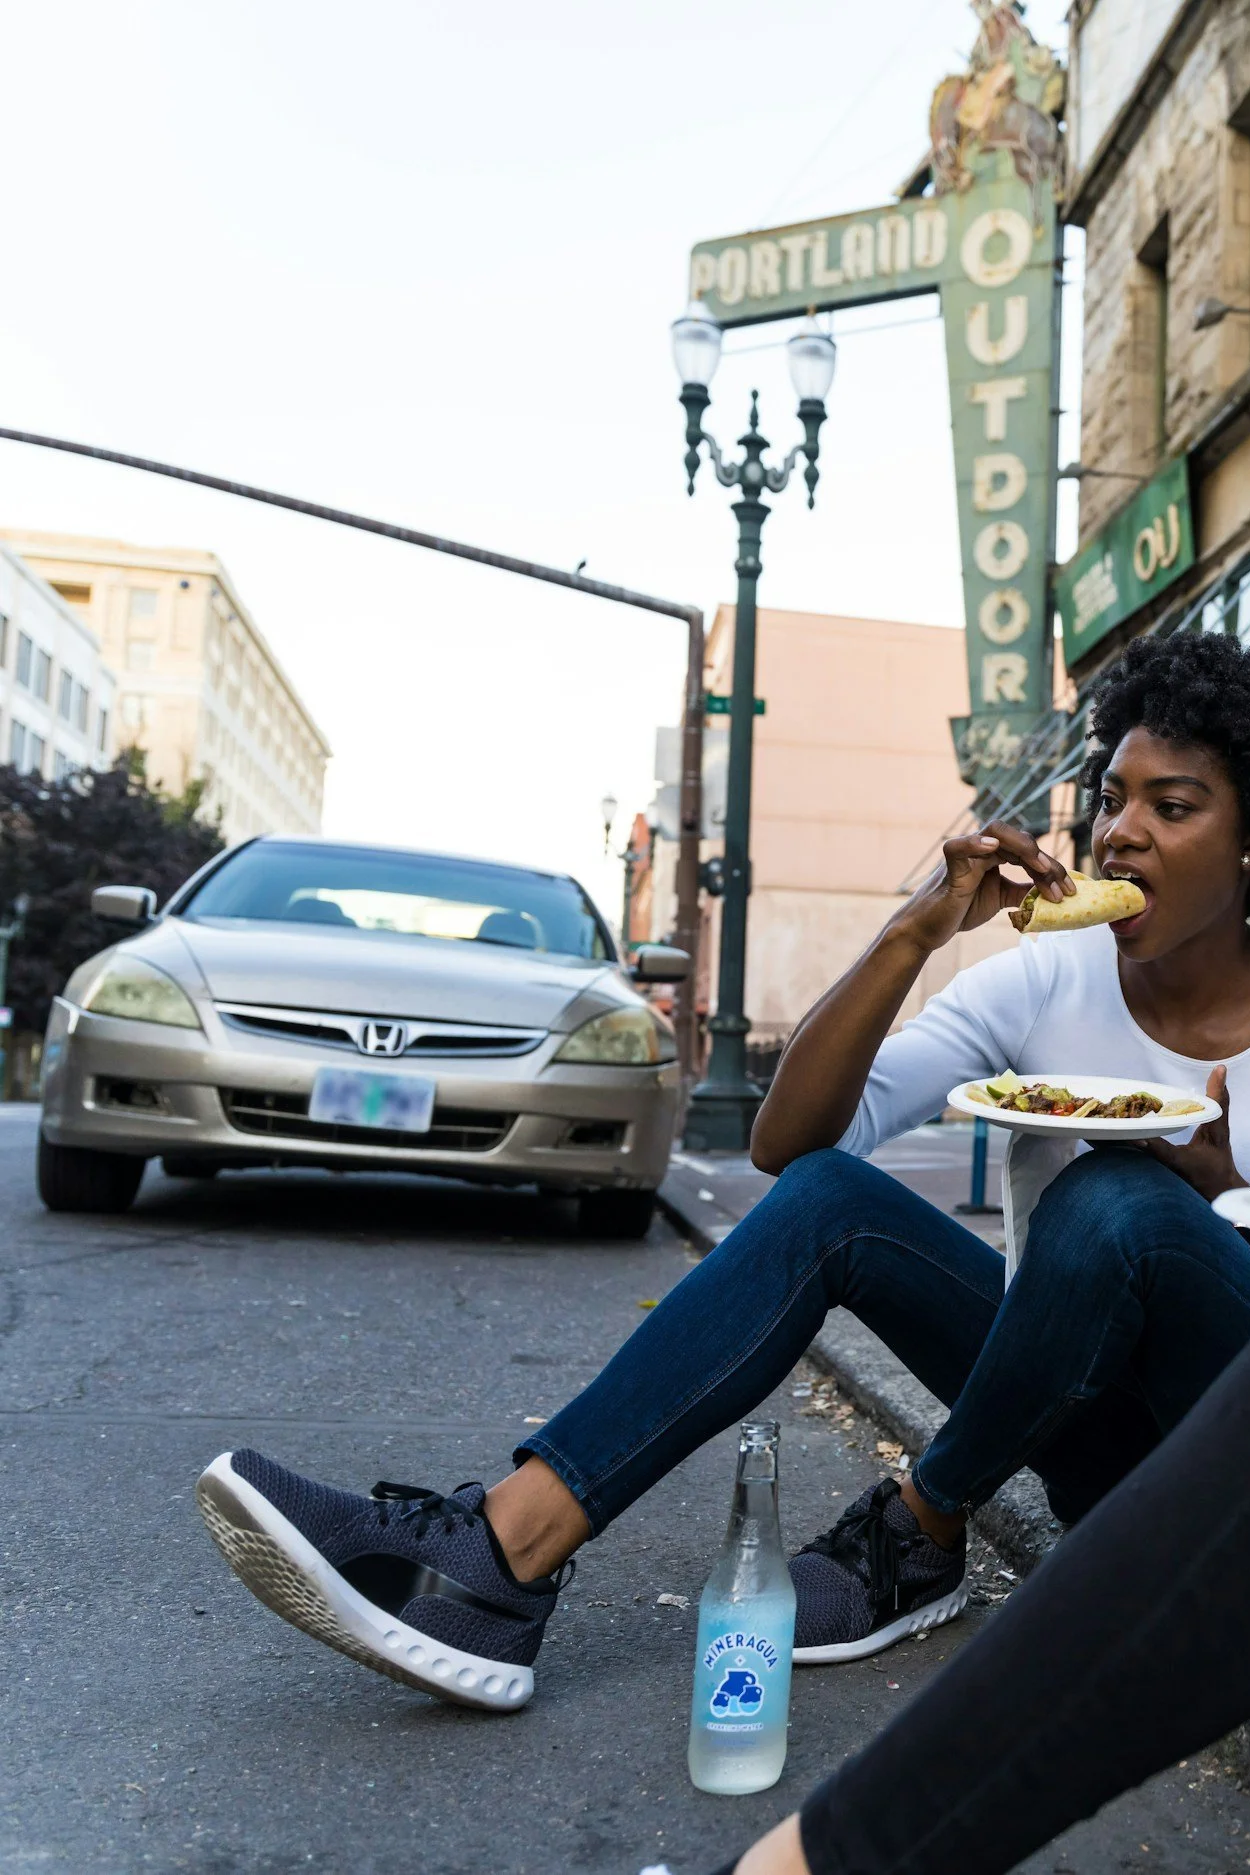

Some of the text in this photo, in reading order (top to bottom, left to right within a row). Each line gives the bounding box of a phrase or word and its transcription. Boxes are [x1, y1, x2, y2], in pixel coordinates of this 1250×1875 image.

[692, 208, 948, 305] PORTLAND
[959, 207, 1033, 704] OUTDOOR
[1133, 503, 1180, 582] OU
[704, 1633, 778, 1669] MINERAGUA
